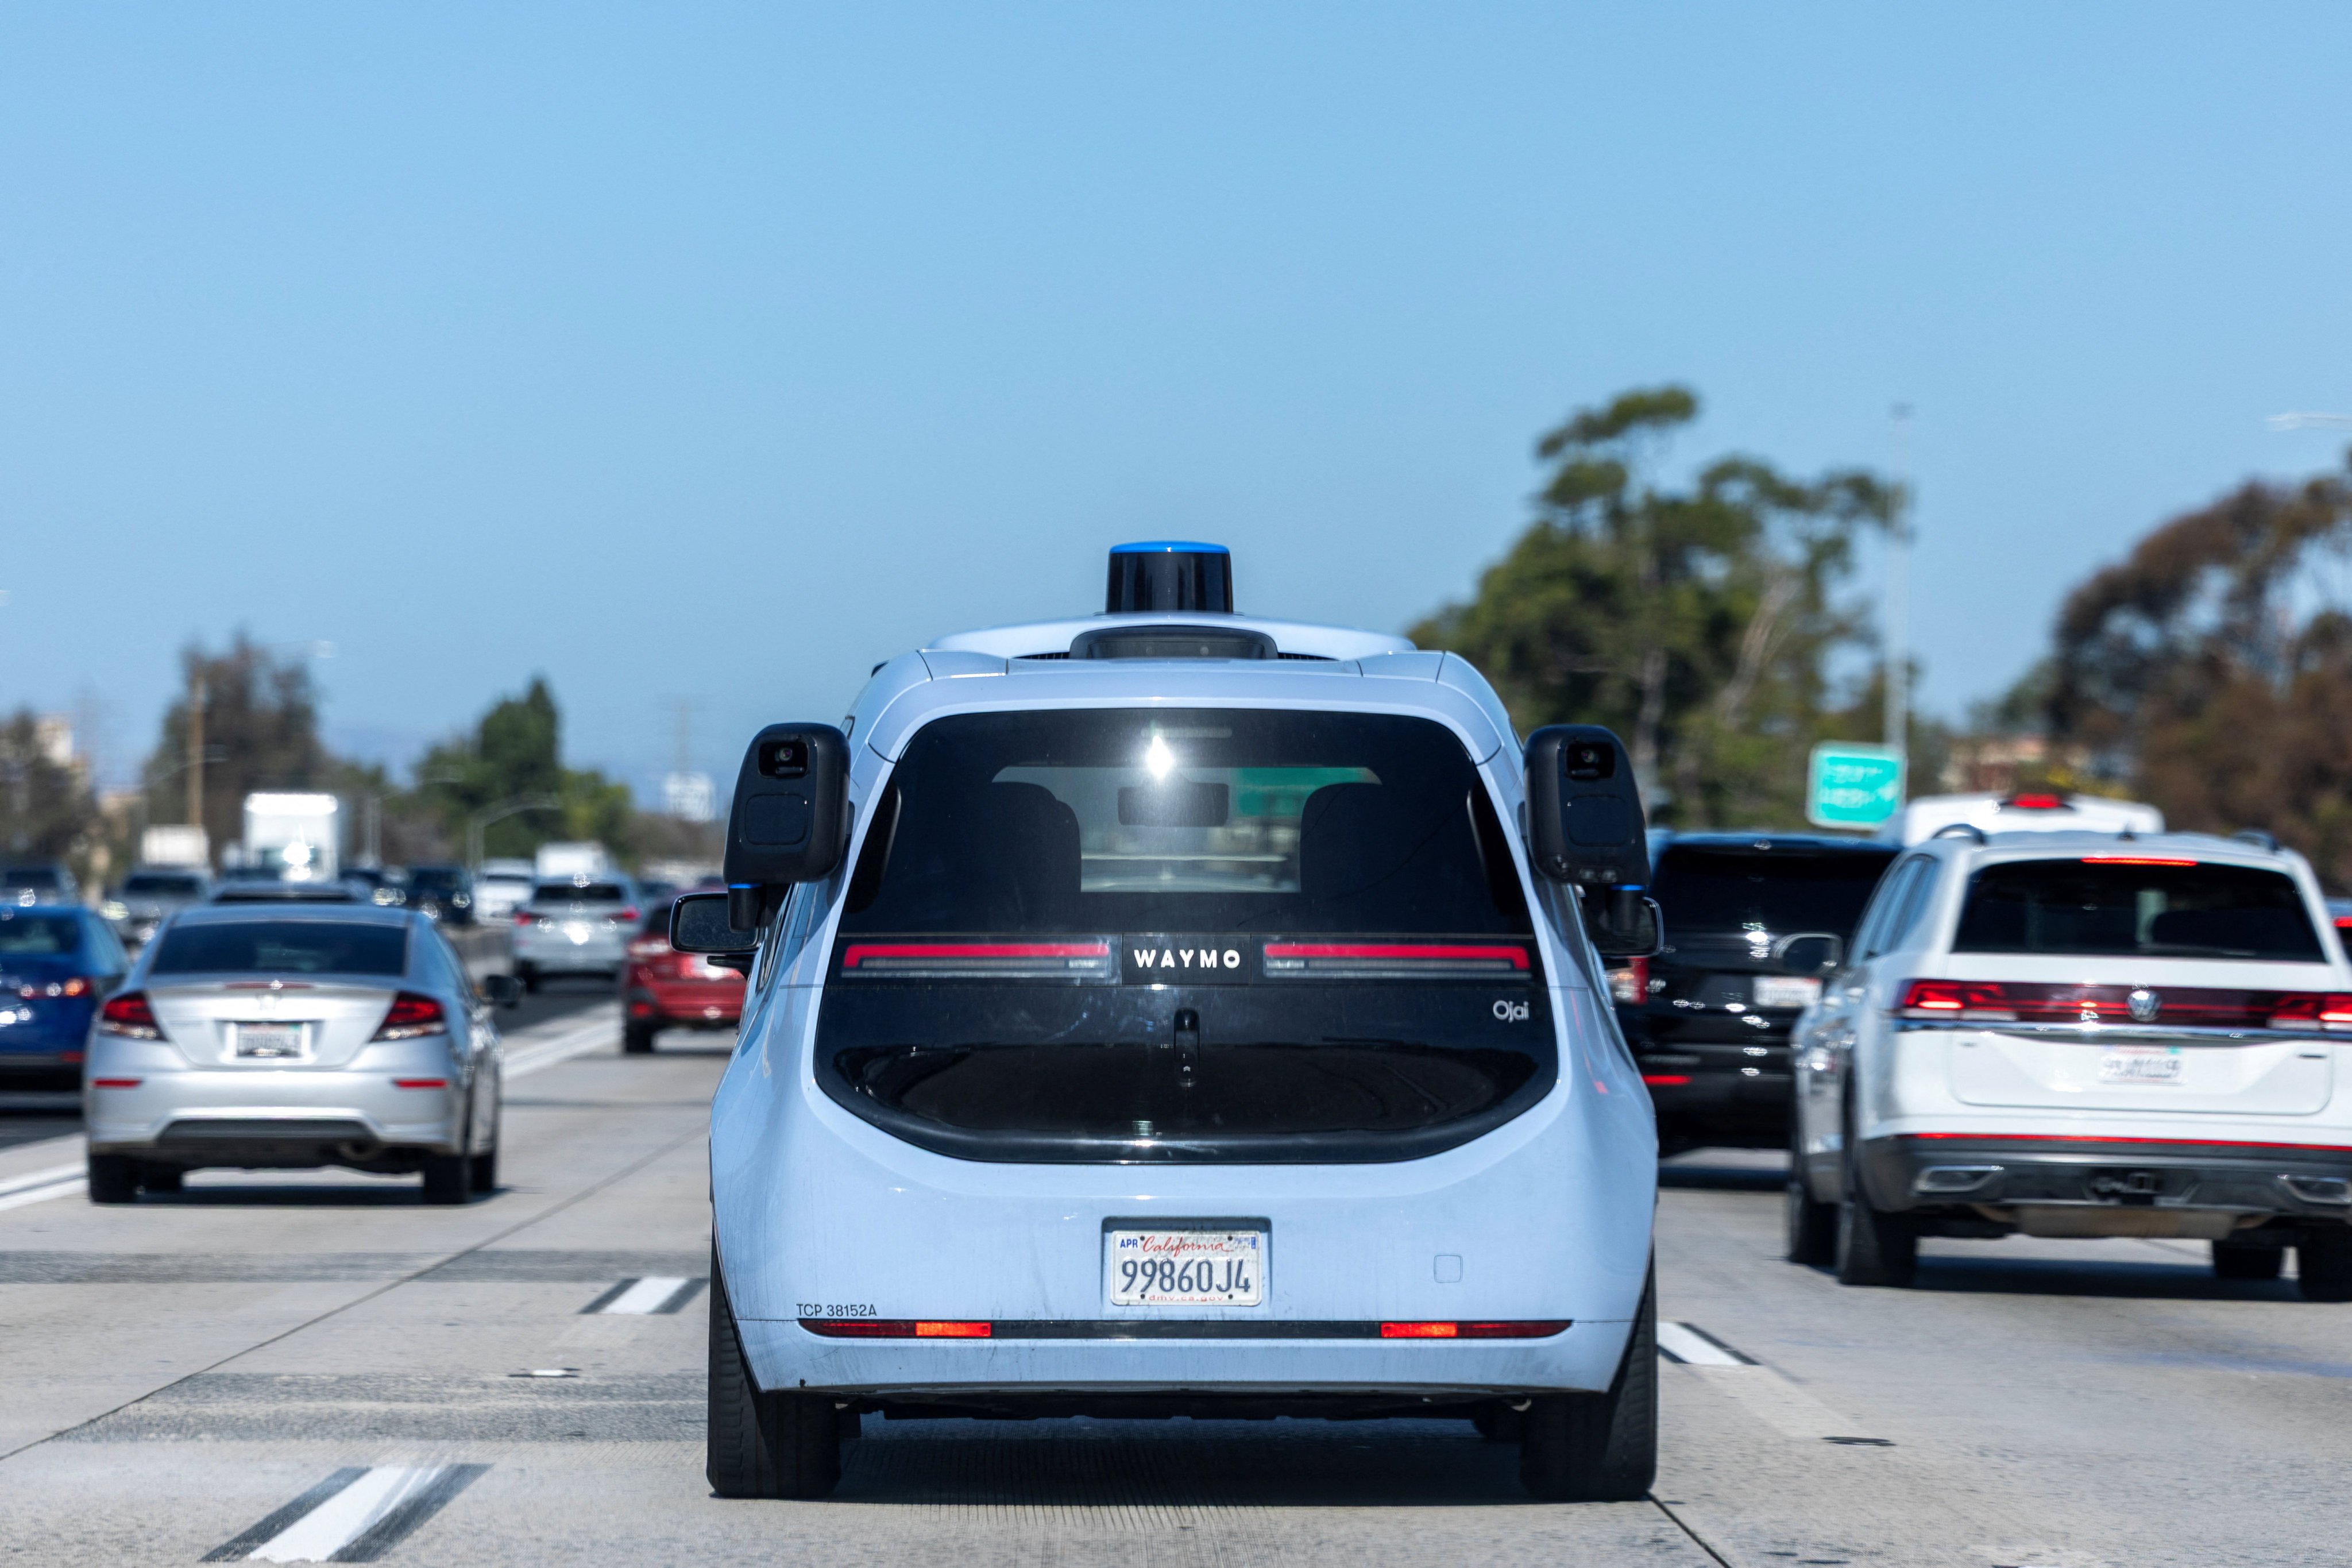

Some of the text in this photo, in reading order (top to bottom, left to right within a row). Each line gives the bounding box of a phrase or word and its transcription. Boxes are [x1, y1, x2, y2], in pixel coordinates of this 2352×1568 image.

[1134, 949, 1240, 969] WAYMO
[1493, 1000, 1529, 1023] Ojai
[1120, 1238, 1138, 1249] APR
[1142, 1235, 1234, 1257] California
[1121, 1258, 1250, 1293] 99860J4
[796, 1303, 878, 1317] TCP 38152A
